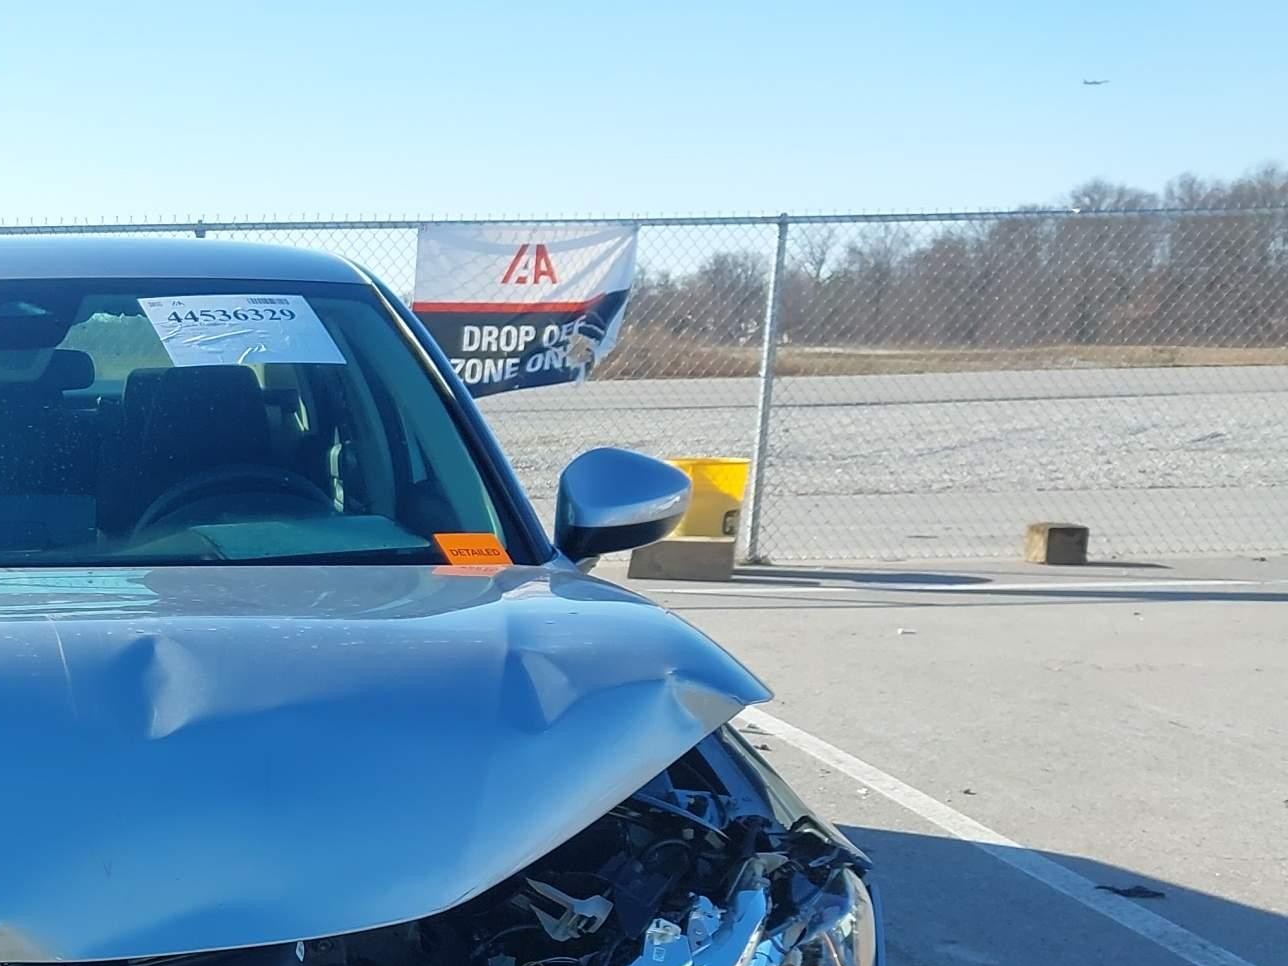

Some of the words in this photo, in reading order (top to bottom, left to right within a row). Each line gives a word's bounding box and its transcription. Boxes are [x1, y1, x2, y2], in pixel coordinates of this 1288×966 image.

[167, 308, 297, 323] 44536329
[462, 325, 537, 353] DROP
[450, 357, 521, 385] ZONE
[449, 548, 502, 557] DETAILED
